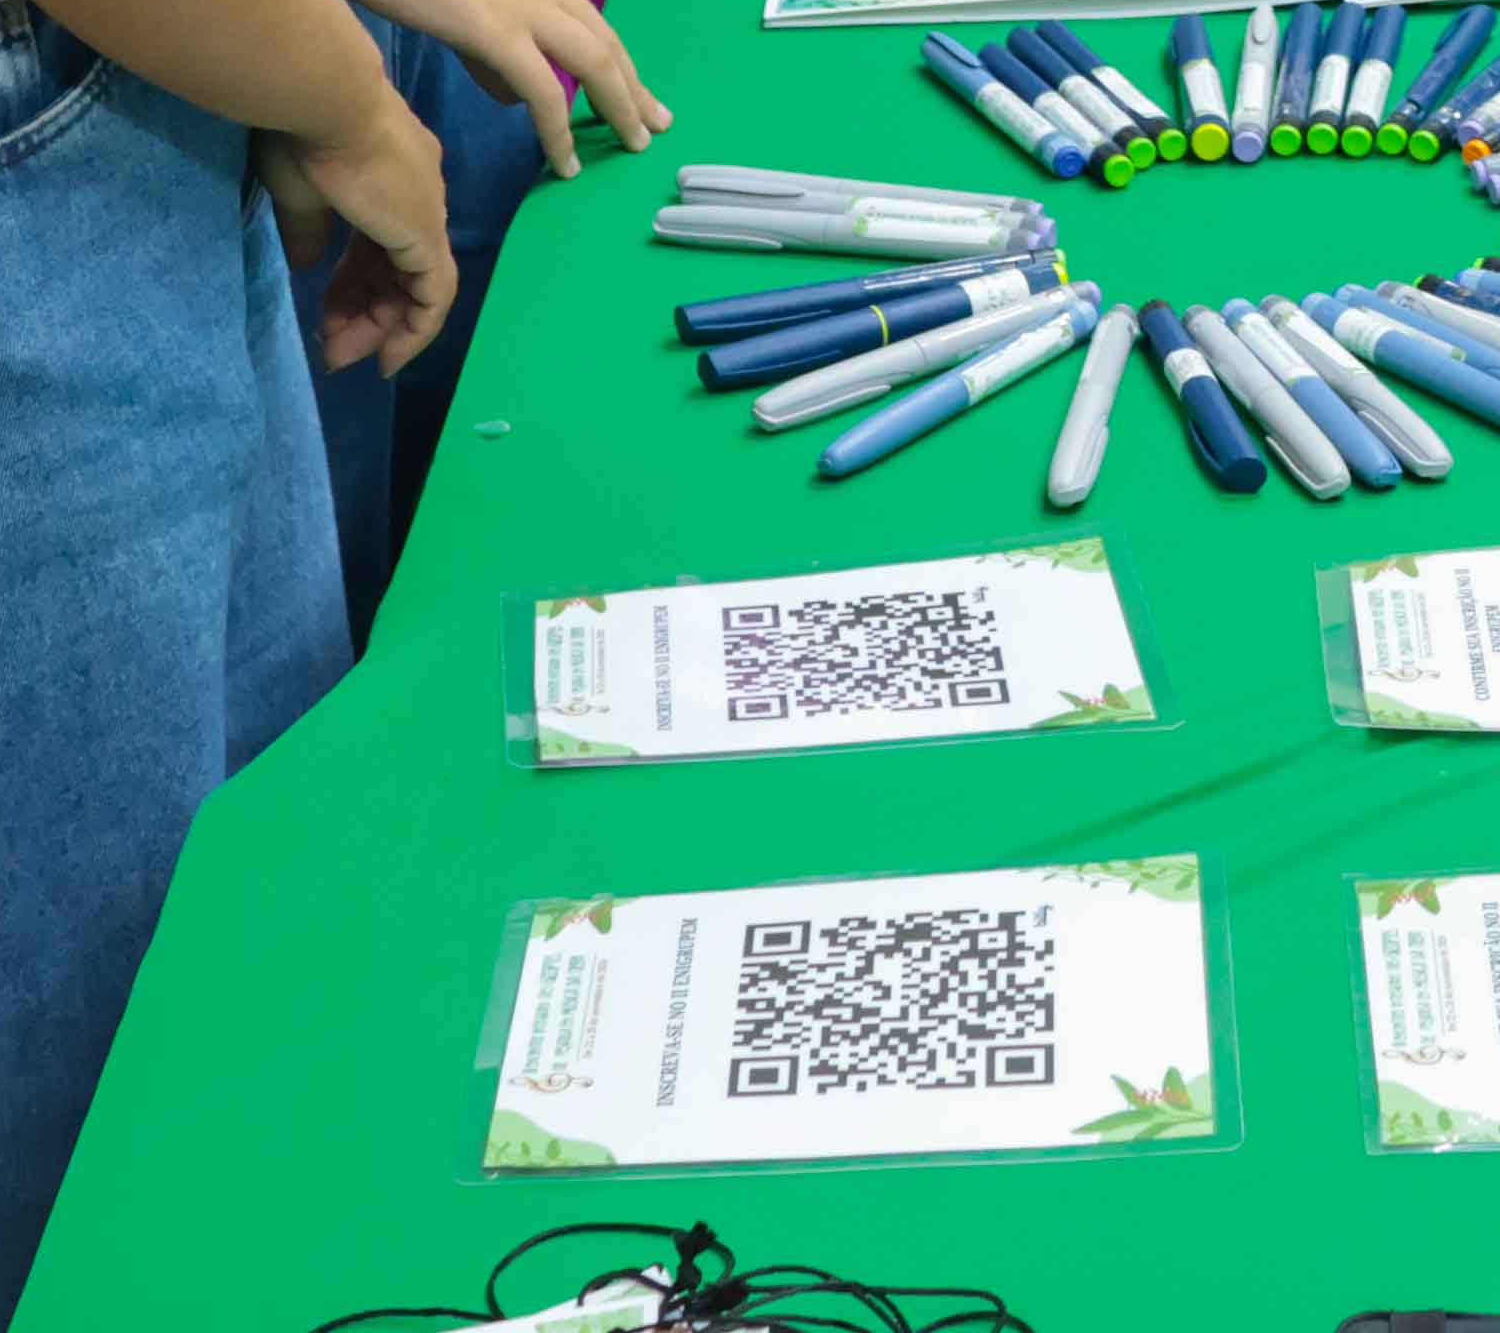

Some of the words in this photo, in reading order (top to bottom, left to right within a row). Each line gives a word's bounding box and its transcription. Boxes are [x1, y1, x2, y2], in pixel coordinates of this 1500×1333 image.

[673, 917, 699, 987] ENIGRUPEM
[668, 1001, 687, 1020] NO
[656, 1020, 684, 1107] INSCREVA-SE
